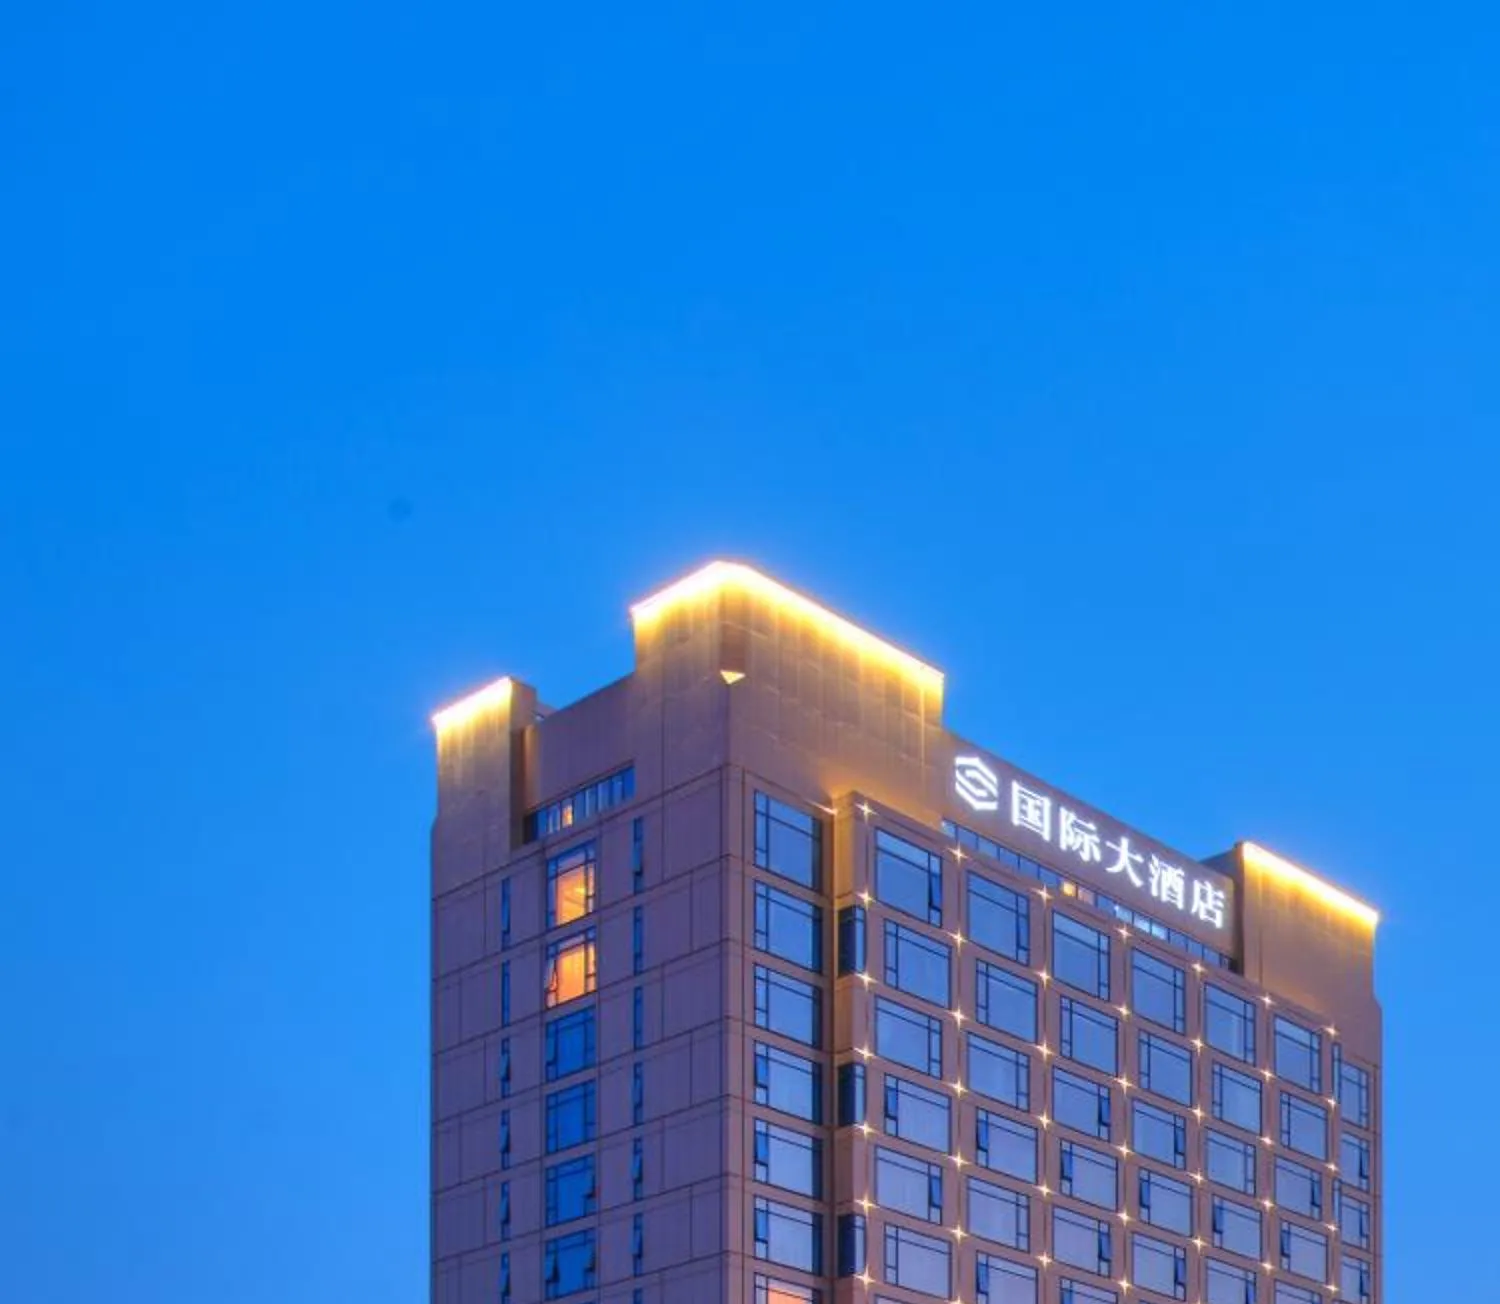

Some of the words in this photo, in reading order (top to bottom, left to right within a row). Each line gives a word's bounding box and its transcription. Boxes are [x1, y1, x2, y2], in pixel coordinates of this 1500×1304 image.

[1011, 780, 1225, 929] 国际大酒店
